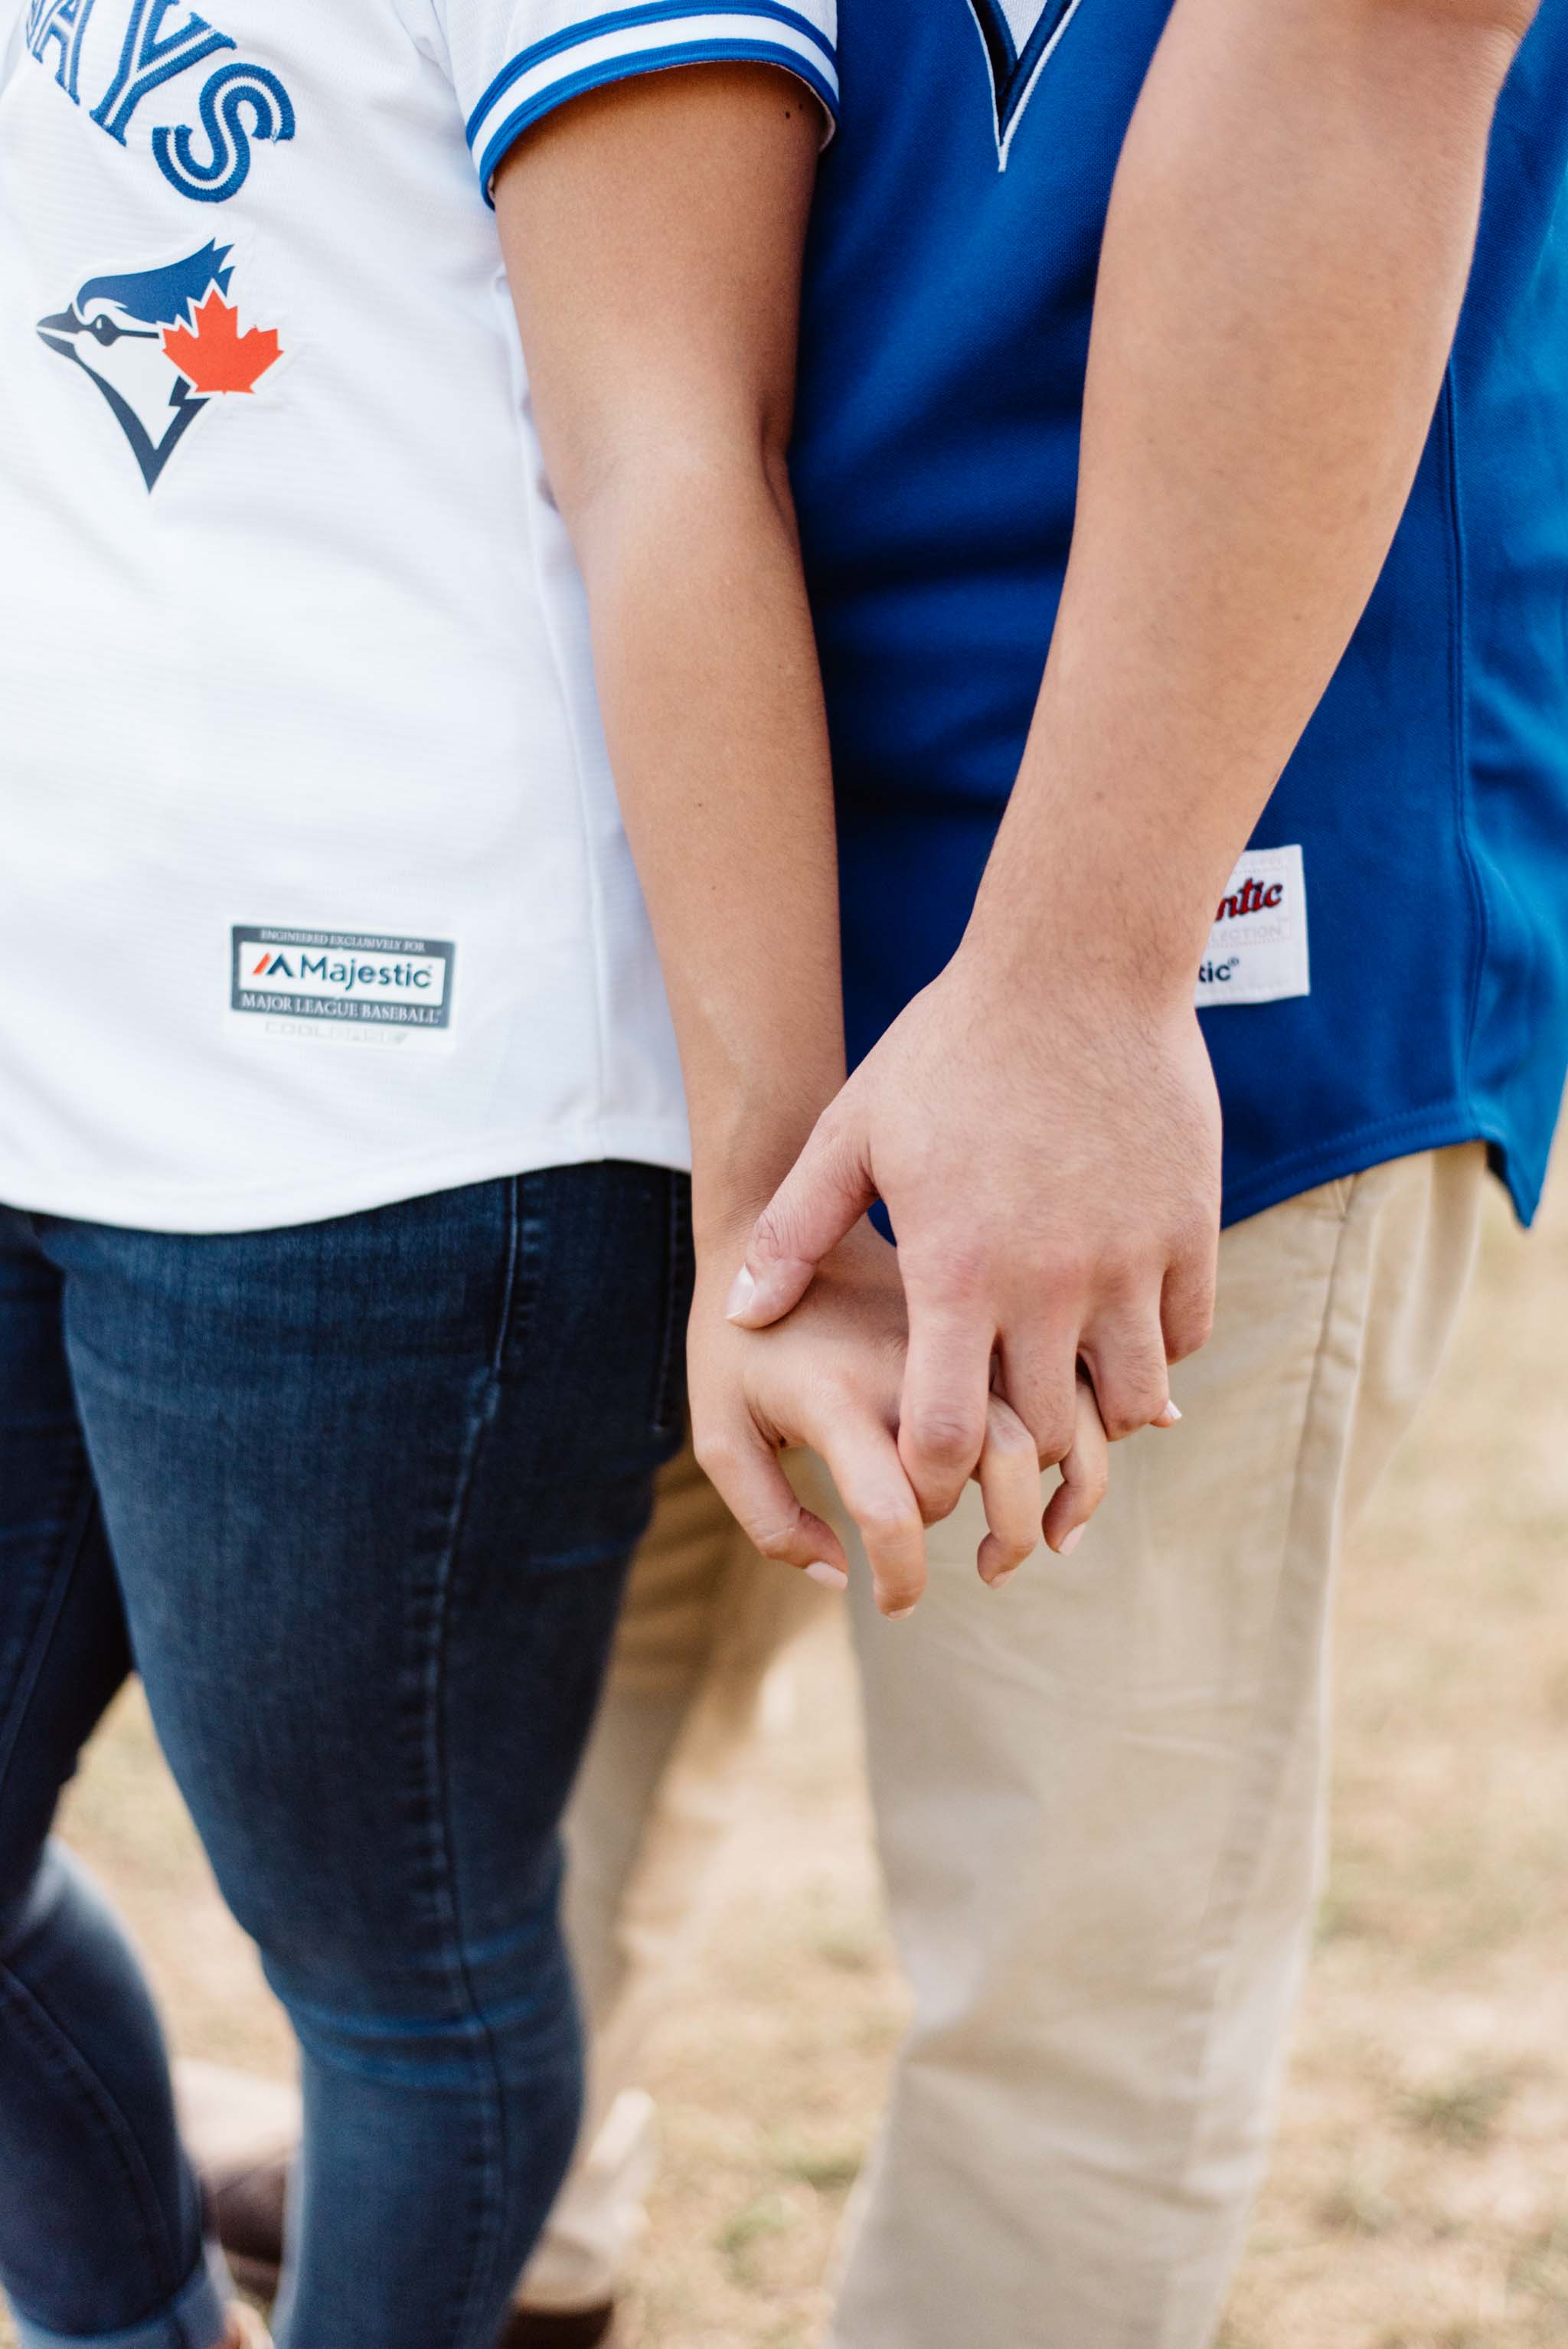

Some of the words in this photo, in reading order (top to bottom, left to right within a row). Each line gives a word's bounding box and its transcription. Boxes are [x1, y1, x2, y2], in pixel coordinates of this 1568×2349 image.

[26, 0, 296, 202] AYS
[260, 929, 328, 945] ENGINEERED
[330, 935, 402, 950] EXCLUSIVELY
[403, 941, 426, 952] FOR
[300, 954, 433, 991] Majestic
[241, 992, 292, 1009] MAJOR
[296, 995, 358, 1017] LEAGUE
